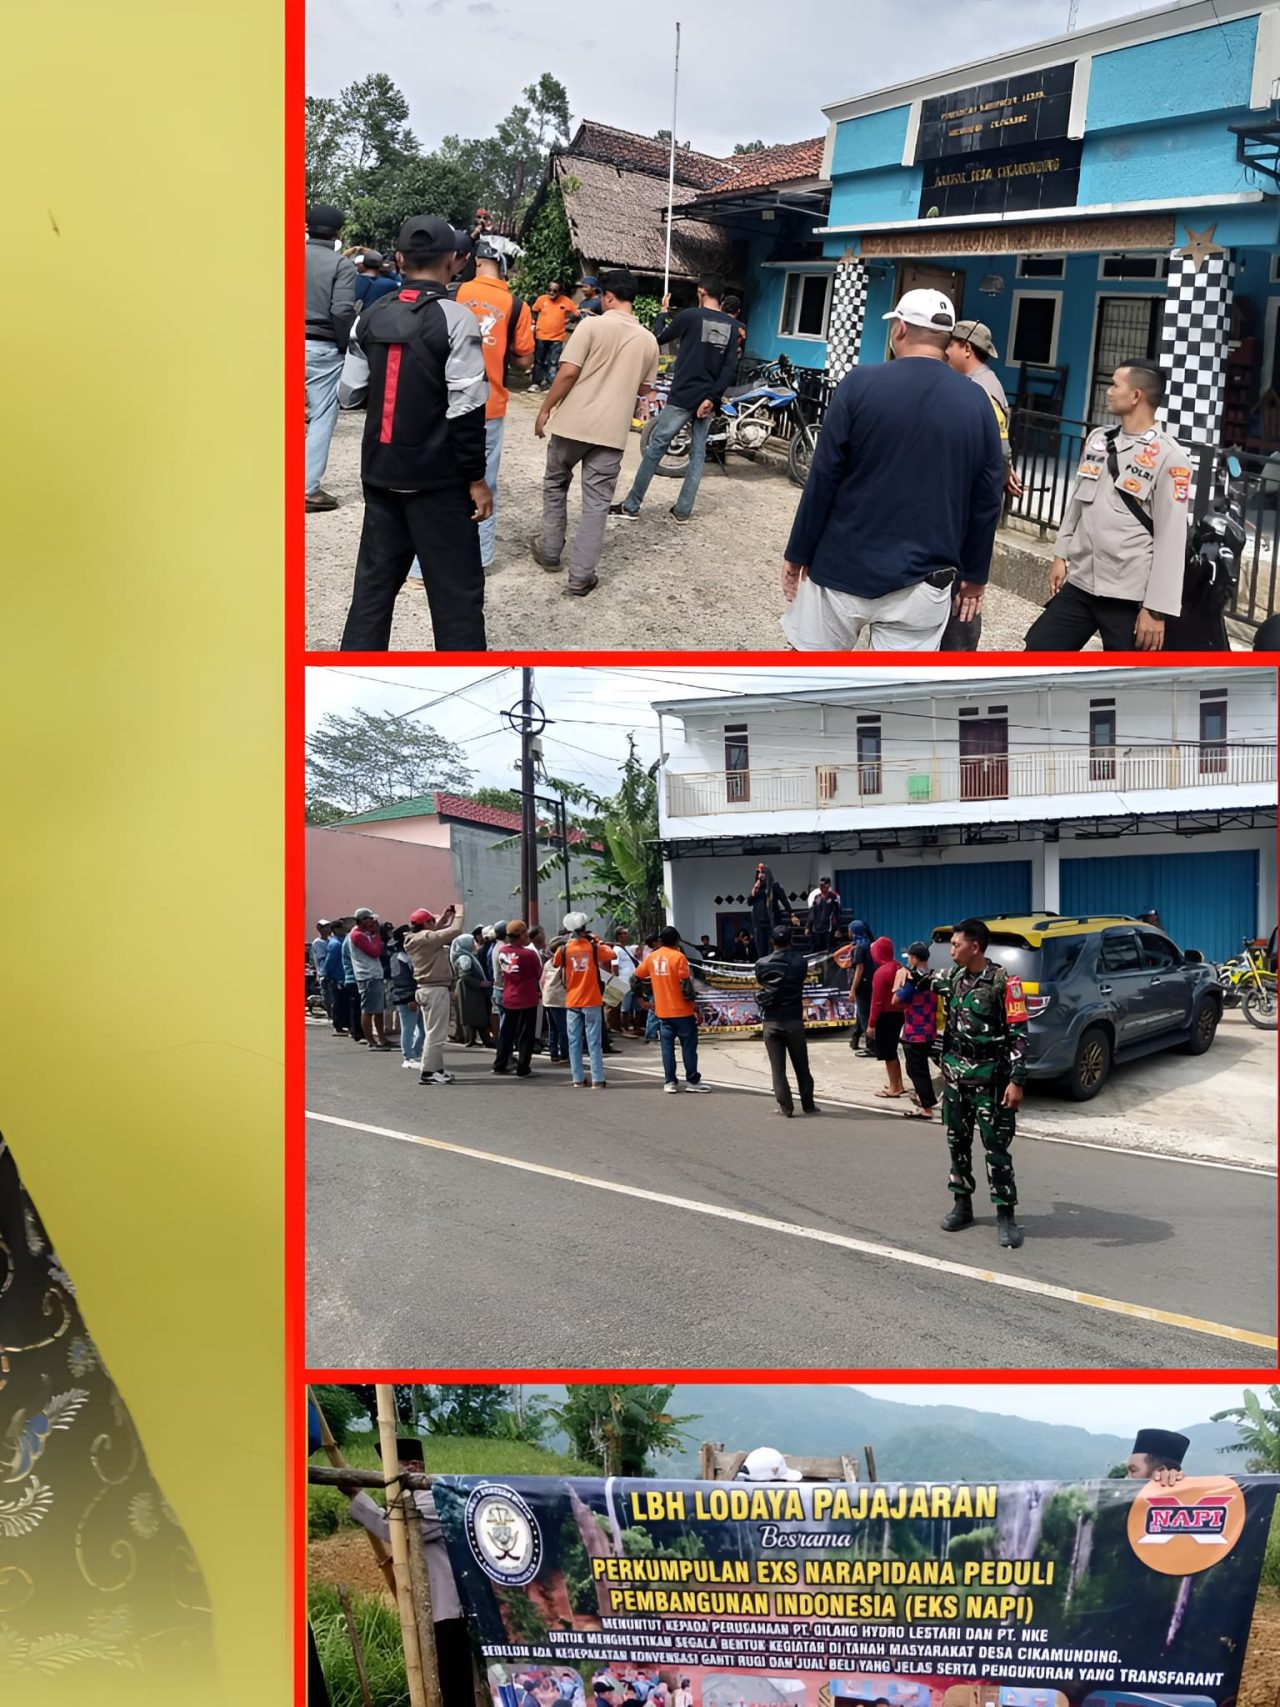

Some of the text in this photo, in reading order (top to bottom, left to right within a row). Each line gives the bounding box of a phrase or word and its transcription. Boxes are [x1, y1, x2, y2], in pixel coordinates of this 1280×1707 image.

[630, 1485, 998, 1521] LBH LODAYA PAJAJARAN
[1151, 1509, 1224, 1527] NAPI
[592, 1558, 750, 1583] PERKUMPULAN
[805, 1560, 956, 1585] NARAPIDANA
[963, 1560, 1055, 1585] PEDULI
[609, 1590, 1034, 1624] PEMBANGUNAN INDONESIA (EKS NAPI)
[602, 1617, 662, 1631] MENUNTUT
[665, 1619, 709, 1632] KEPADA
[793, 1624, 810, 1636] PT.
[862, 1625, 904, 1638] HYDRO
[909, 1626, 961, 1640] LESTARI
[965, 1628, 993, 1641] DAN
[997, 1629, 1016, 1642] PT.
[1022, 1629, 1048, 1642] NKE
[549, 1632, 1122, 1664] UNTUK MENGHENTIKAN SEGALA BENTUK KEGIATAN DI TANAH MASYARAKAT DESA CIKAMUNDING.
[481, 1645, 530, 1657] SEBELUM
[555, 1648, 627, 1662] KESEPAKATAN
[701, 1654, 734, 1667] GANTI
[738, 1655, 766, 1668] RUGI
[770, 1656, 793, 1669] DAN
[796, 1657, 826, 1670] JUAL
[829, 1658, 855, 1671] BELI
[859, 1659, 890, 1673] YANG
[894, 1661, 932, 1674] JELAS
[936, 1662, 977, 1676] SERTA
[981, 1665, 1072, 1680] PENGUKURAN
[1078, 1668, 1114, 1681] YANG
[1120, 1669, 1224, 1686] TRANSFARANT
